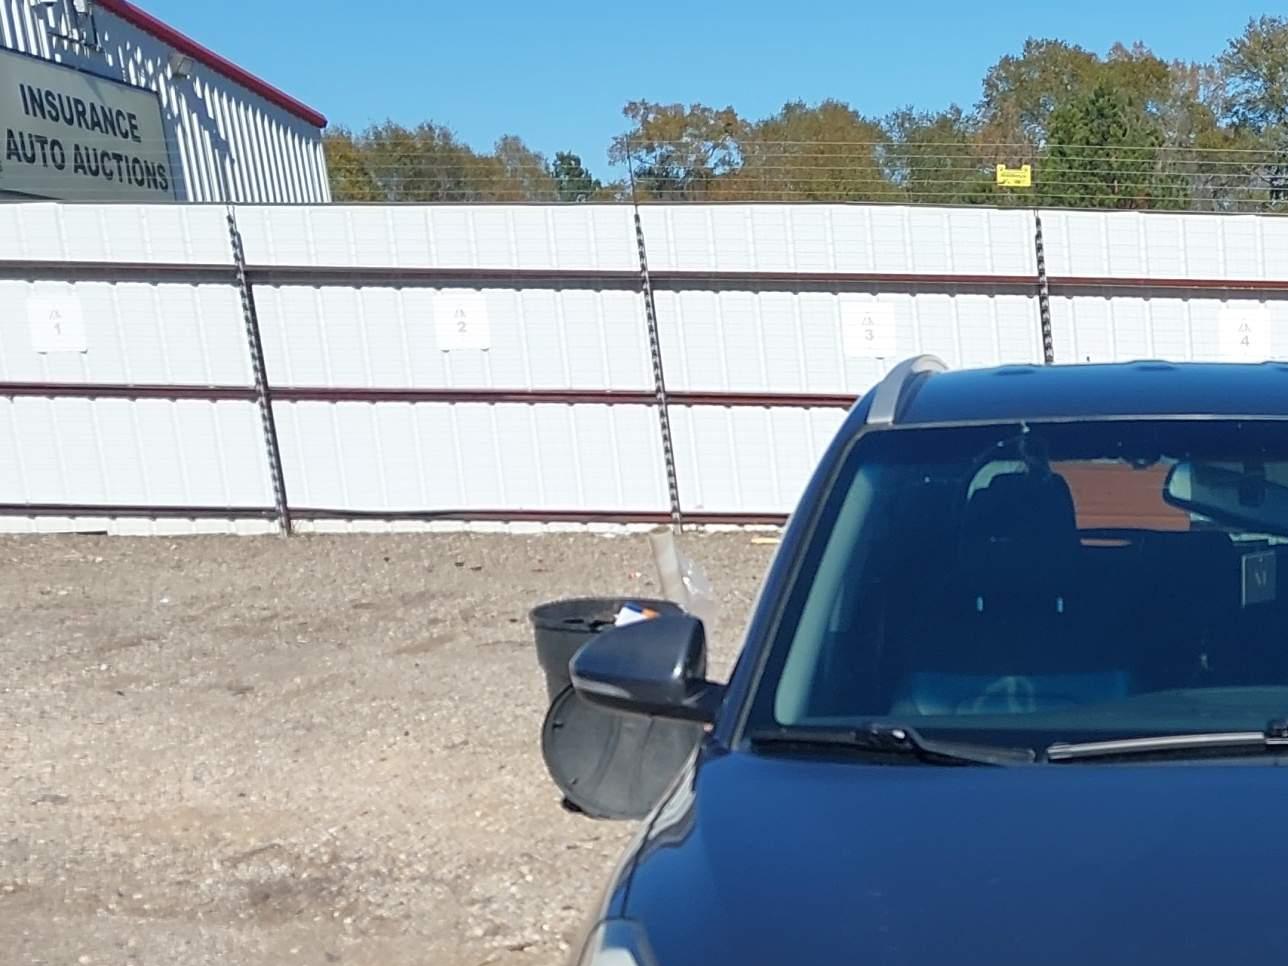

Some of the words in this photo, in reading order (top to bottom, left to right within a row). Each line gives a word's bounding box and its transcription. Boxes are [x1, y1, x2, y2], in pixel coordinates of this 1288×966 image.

[19, 83, 142, 143] INSURANCE
[6, 128, 66, 170] AUTO
[73, 143, 169, 192] AUCTIONS
[457, 321, 467, 334] 2
[865, 329, 875, 341] 3
[1240, 334, 1251, 347] 4
